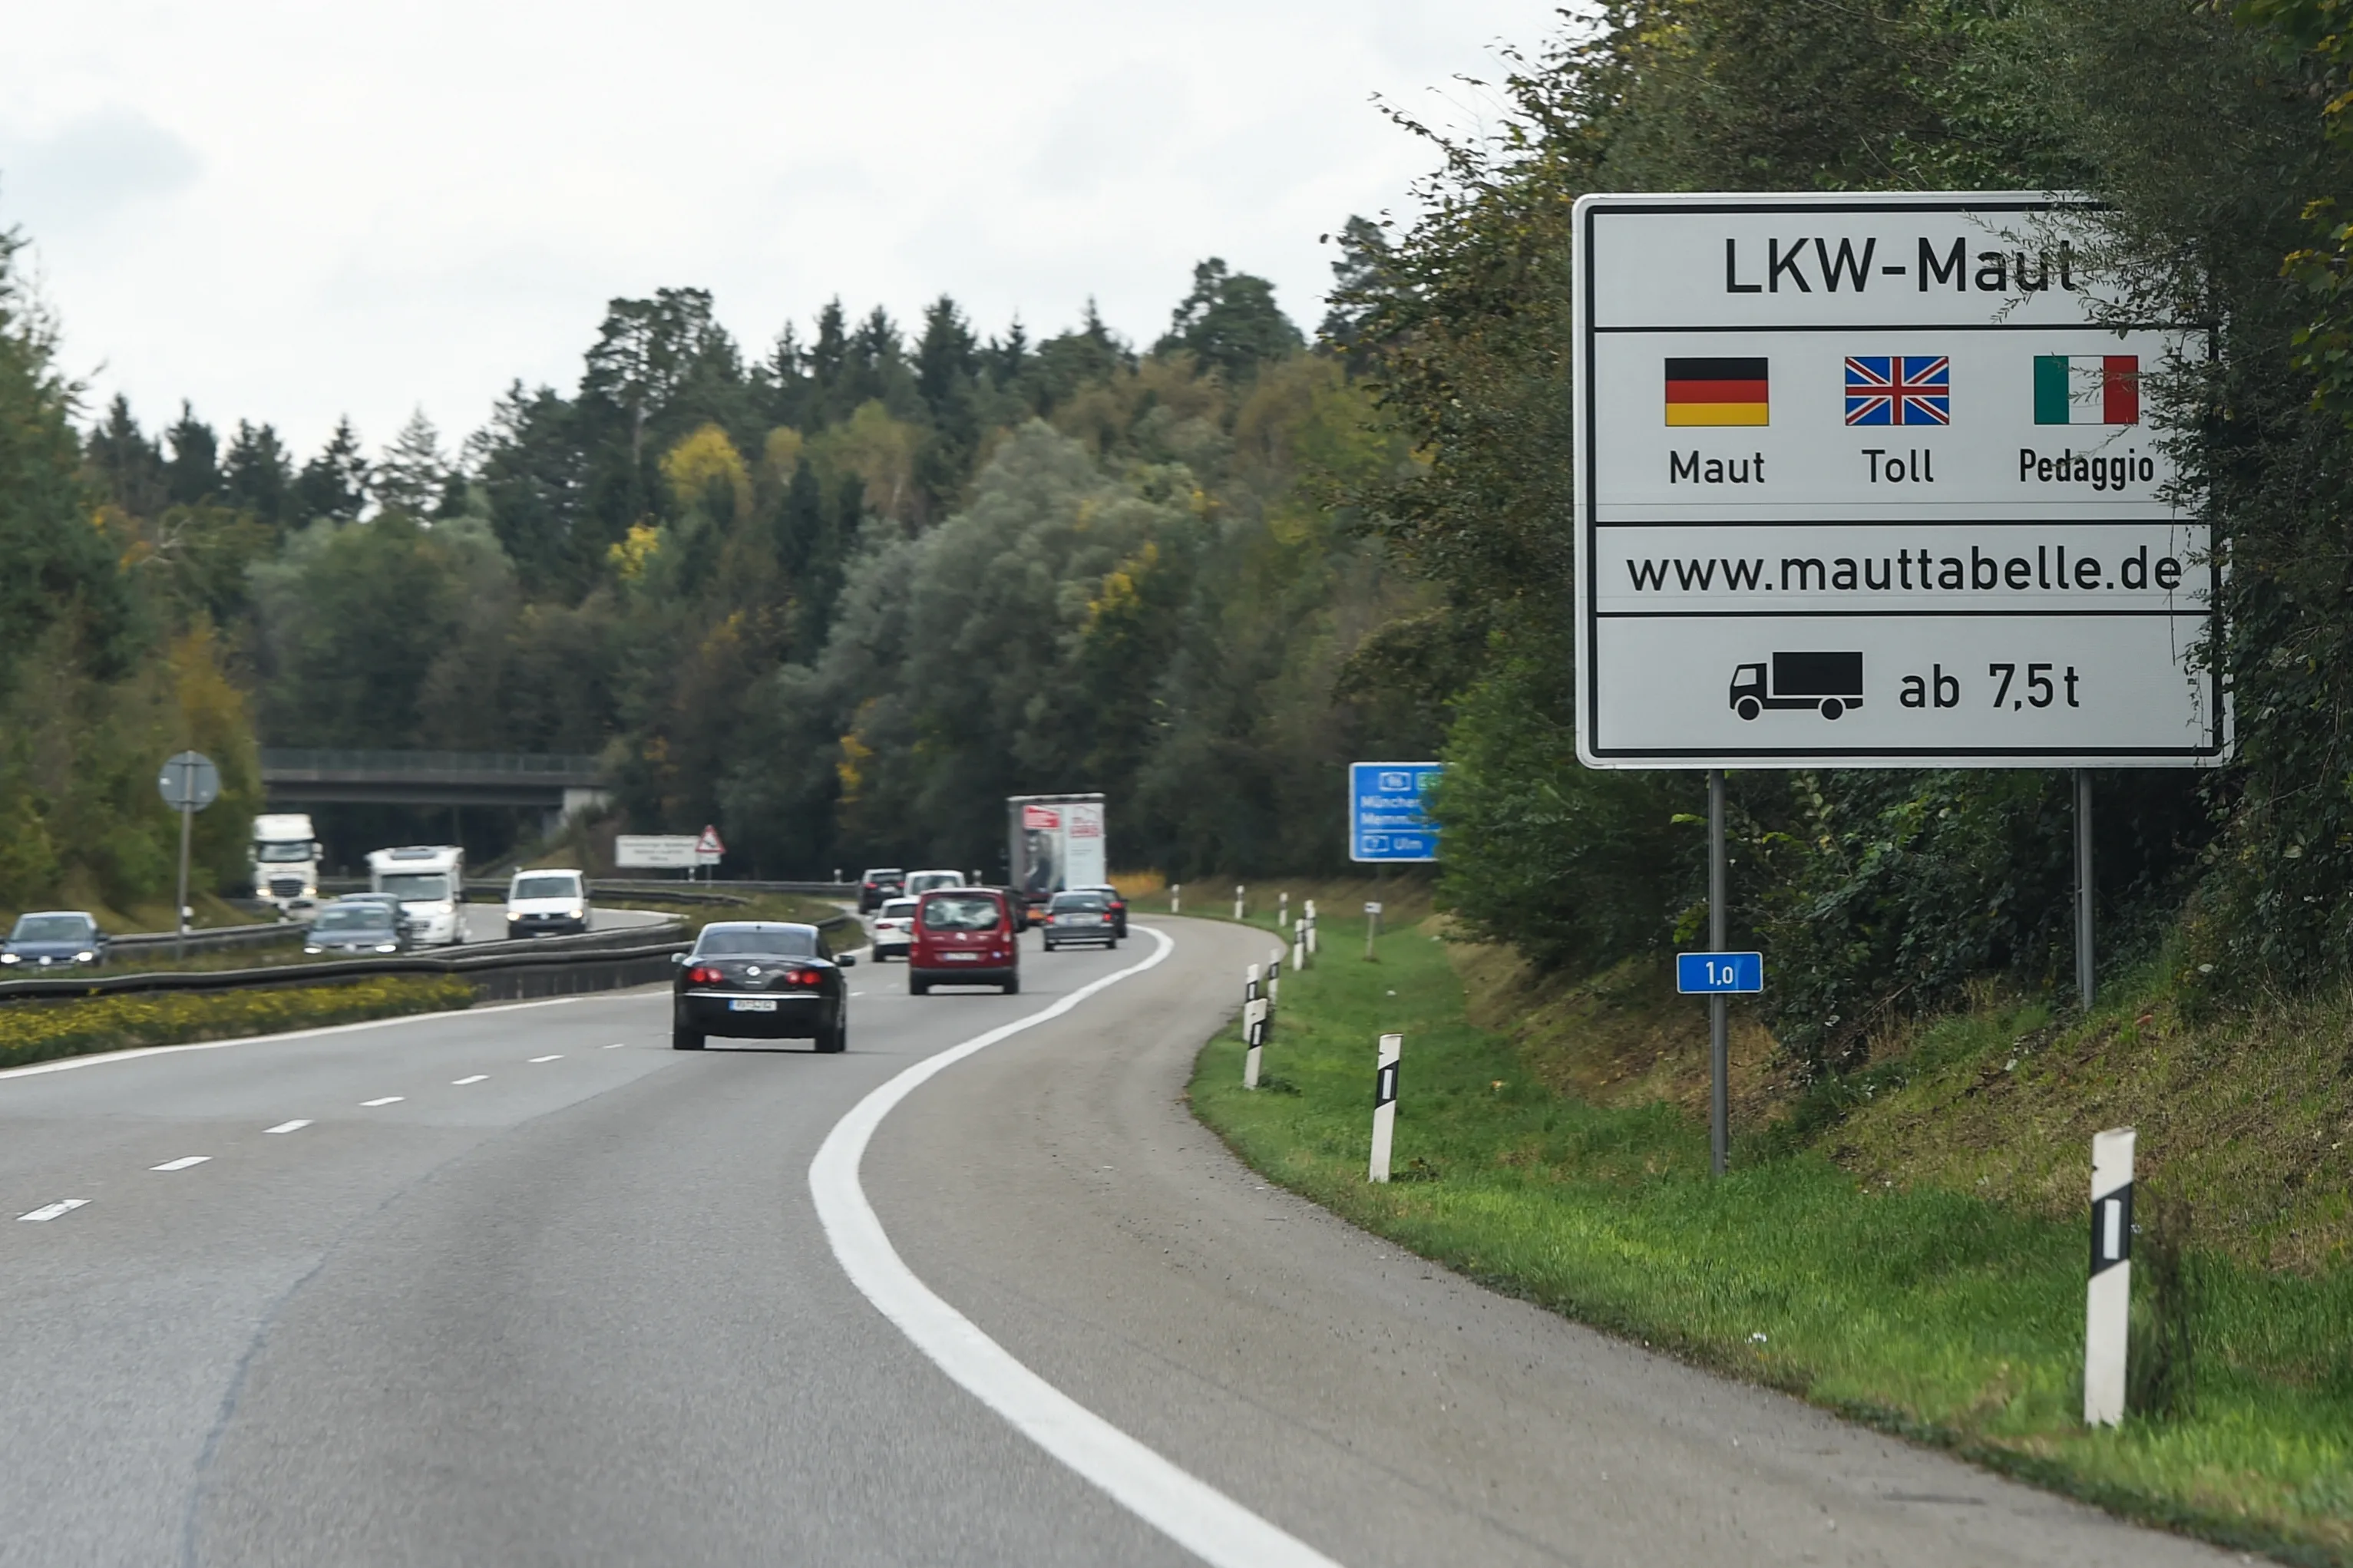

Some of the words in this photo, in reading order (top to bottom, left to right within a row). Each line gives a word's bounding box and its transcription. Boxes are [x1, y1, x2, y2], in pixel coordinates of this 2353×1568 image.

[1726, 236, 2076, 293] LKW-Maut
[1670, 450, 1765, 484] Maut
[1861, 449, 1934, 484] Toll
[2019, 447, 2154, 491] Pedaggio
[1626, 545, 2183, 590] www.mauttabelle.de
[1899, 663, 1960, 708] ab
[1705, 961, 1733, 985] 1,0
